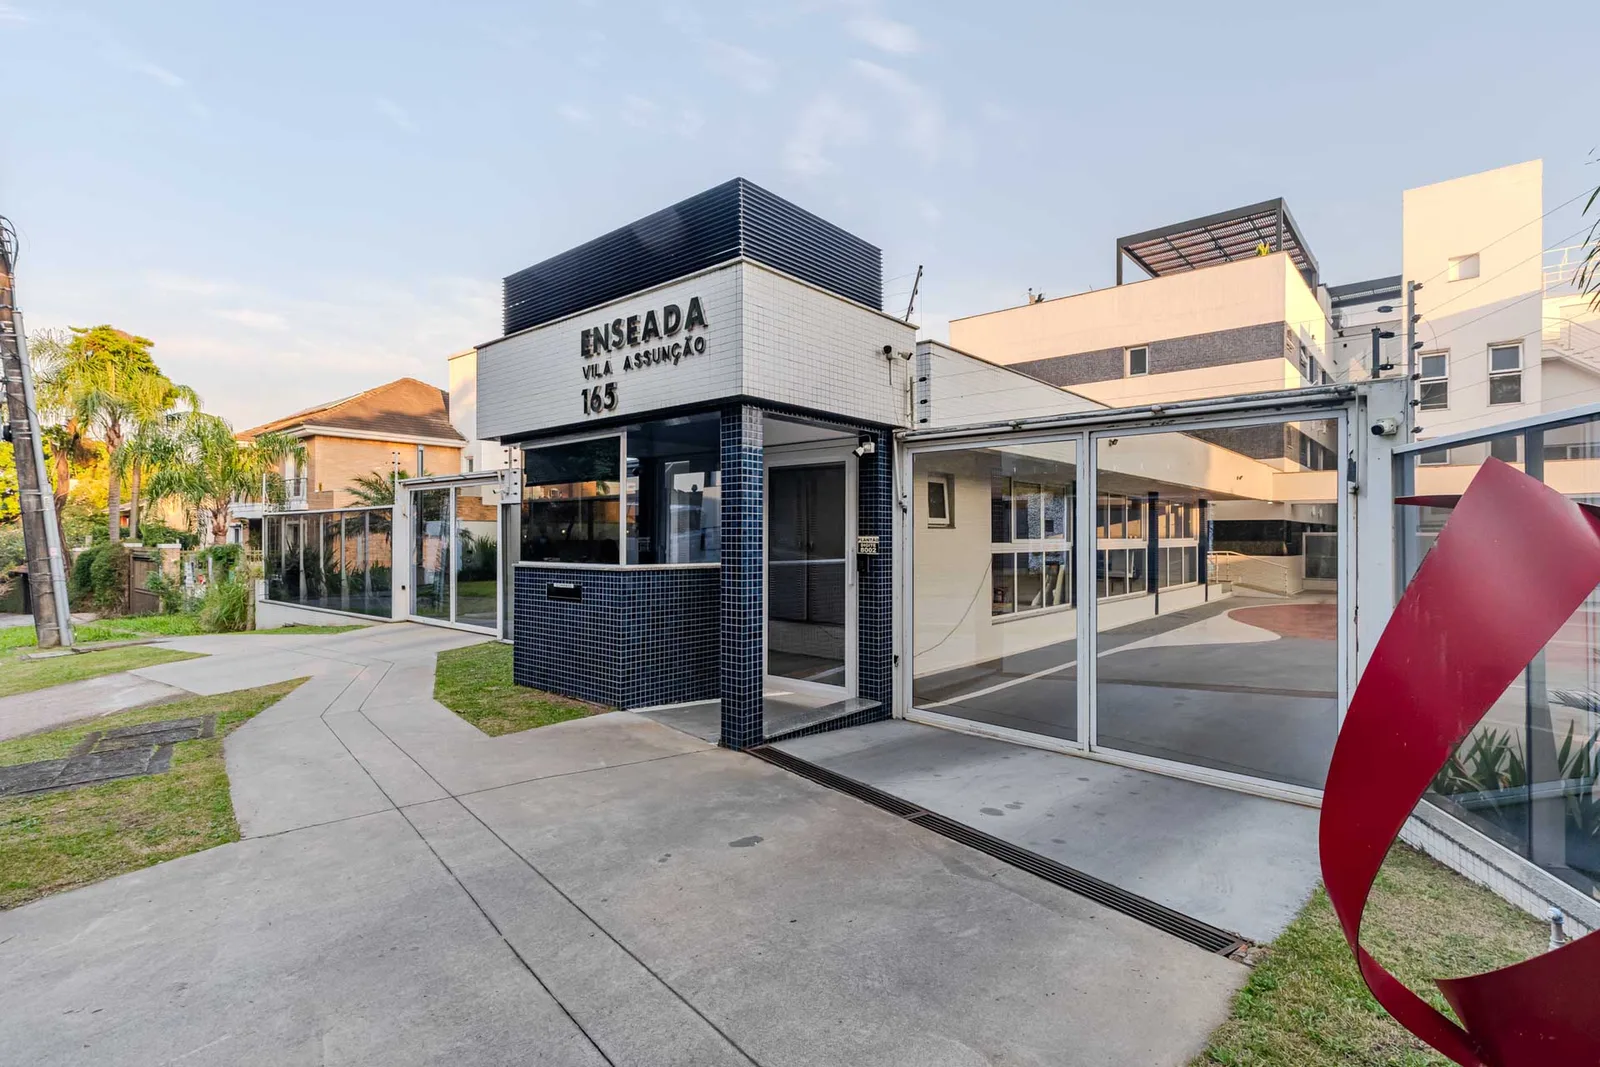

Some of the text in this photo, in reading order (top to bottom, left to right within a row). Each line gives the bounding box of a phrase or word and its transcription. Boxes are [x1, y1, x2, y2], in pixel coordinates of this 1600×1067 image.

[581, 296, 708, 358] ENSEADA
[582, 335, 706, 380] VILA ASSUNÇÃO
[581, 381, 618, 415] 165
